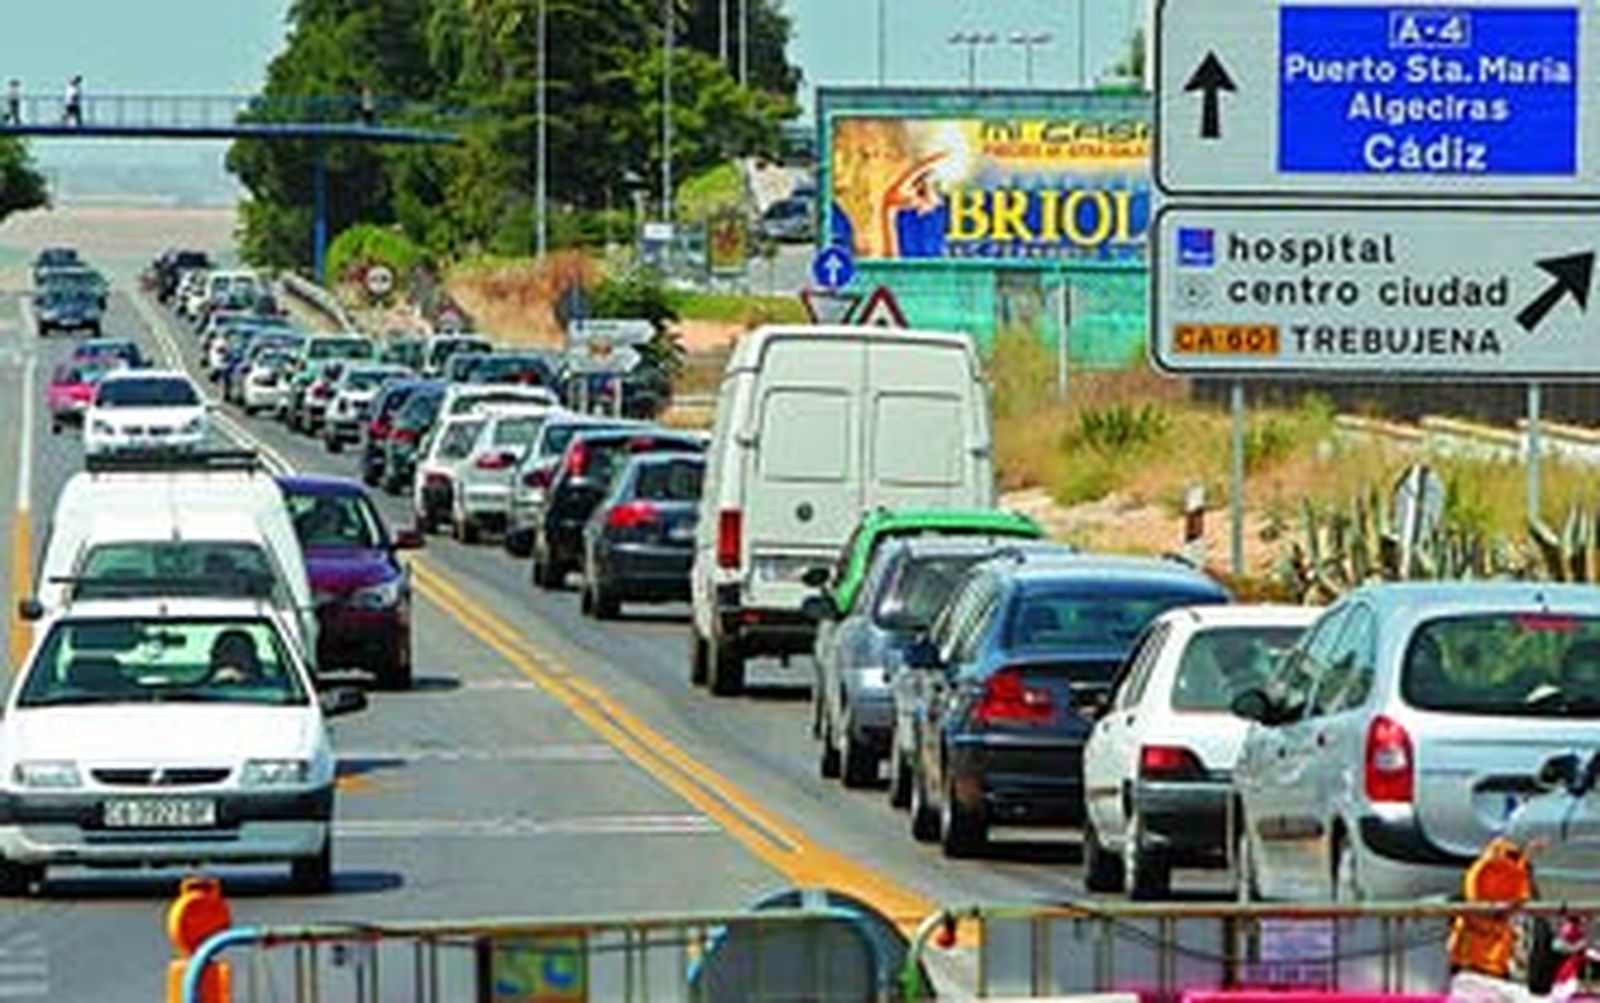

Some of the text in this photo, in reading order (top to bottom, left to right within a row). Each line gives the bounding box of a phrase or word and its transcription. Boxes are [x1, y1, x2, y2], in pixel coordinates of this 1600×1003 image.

[1285, 54, 1396, 84] Puerto
[1405, 54, 1473, 84] Sta.
[1348, 92, 1511, 124] Algeciras
[1363, 132, 1488, 171] Cádiz
[1228, 233, 1394, 267] hospital
[1228, 276, 1509, 307] centro ciudad
[1291, 326, 1502, 355] TREBUJENA
